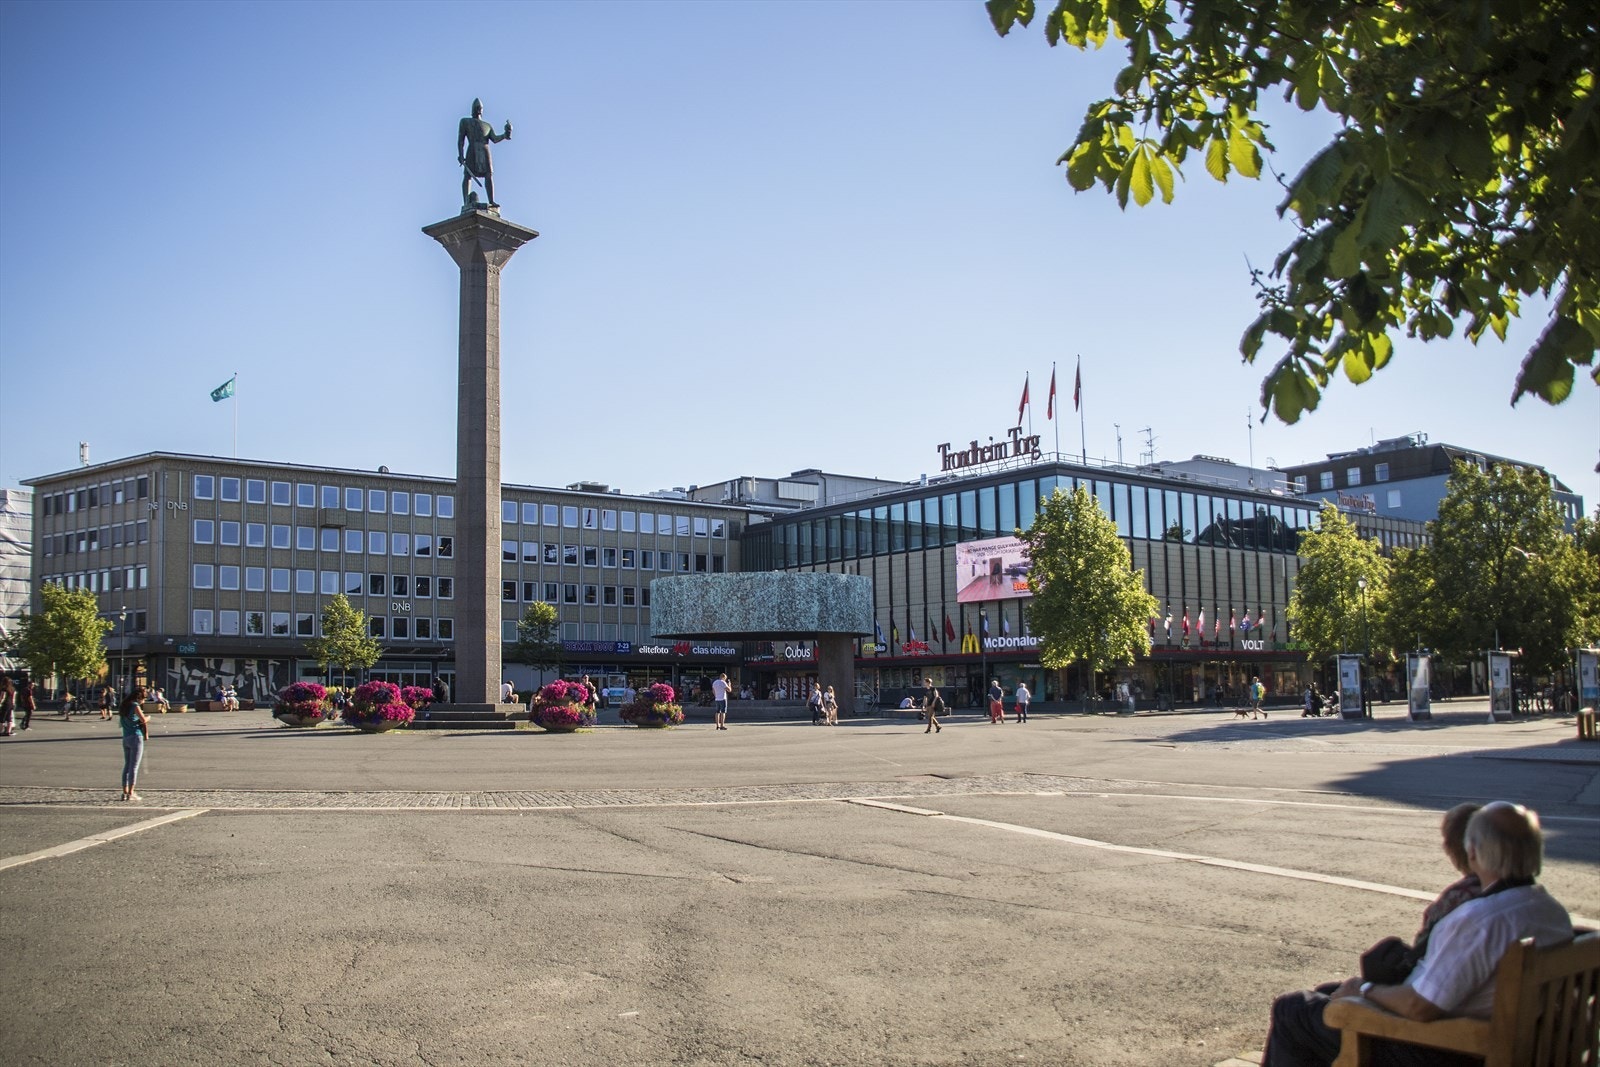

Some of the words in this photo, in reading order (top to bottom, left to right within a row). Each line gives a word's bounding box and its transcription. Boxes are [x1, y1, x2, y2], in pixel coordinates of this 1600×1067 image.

[937, 436, 1008, 472] Trondheim
[1008, 426, 1041, 461] Torg
[167, 500, 188, 519] DNB
[392, 600, 411, 614] DNB
[593, 642, 615, 652] 1000
[639, 646, 669, 654] elitefoto
[692, 646, 709, 655] clas
[709, 646, 735, 655] ohlson
[1241, 639, 1265, 650] VOLT
[785, 645, 811, 659] Cubus
